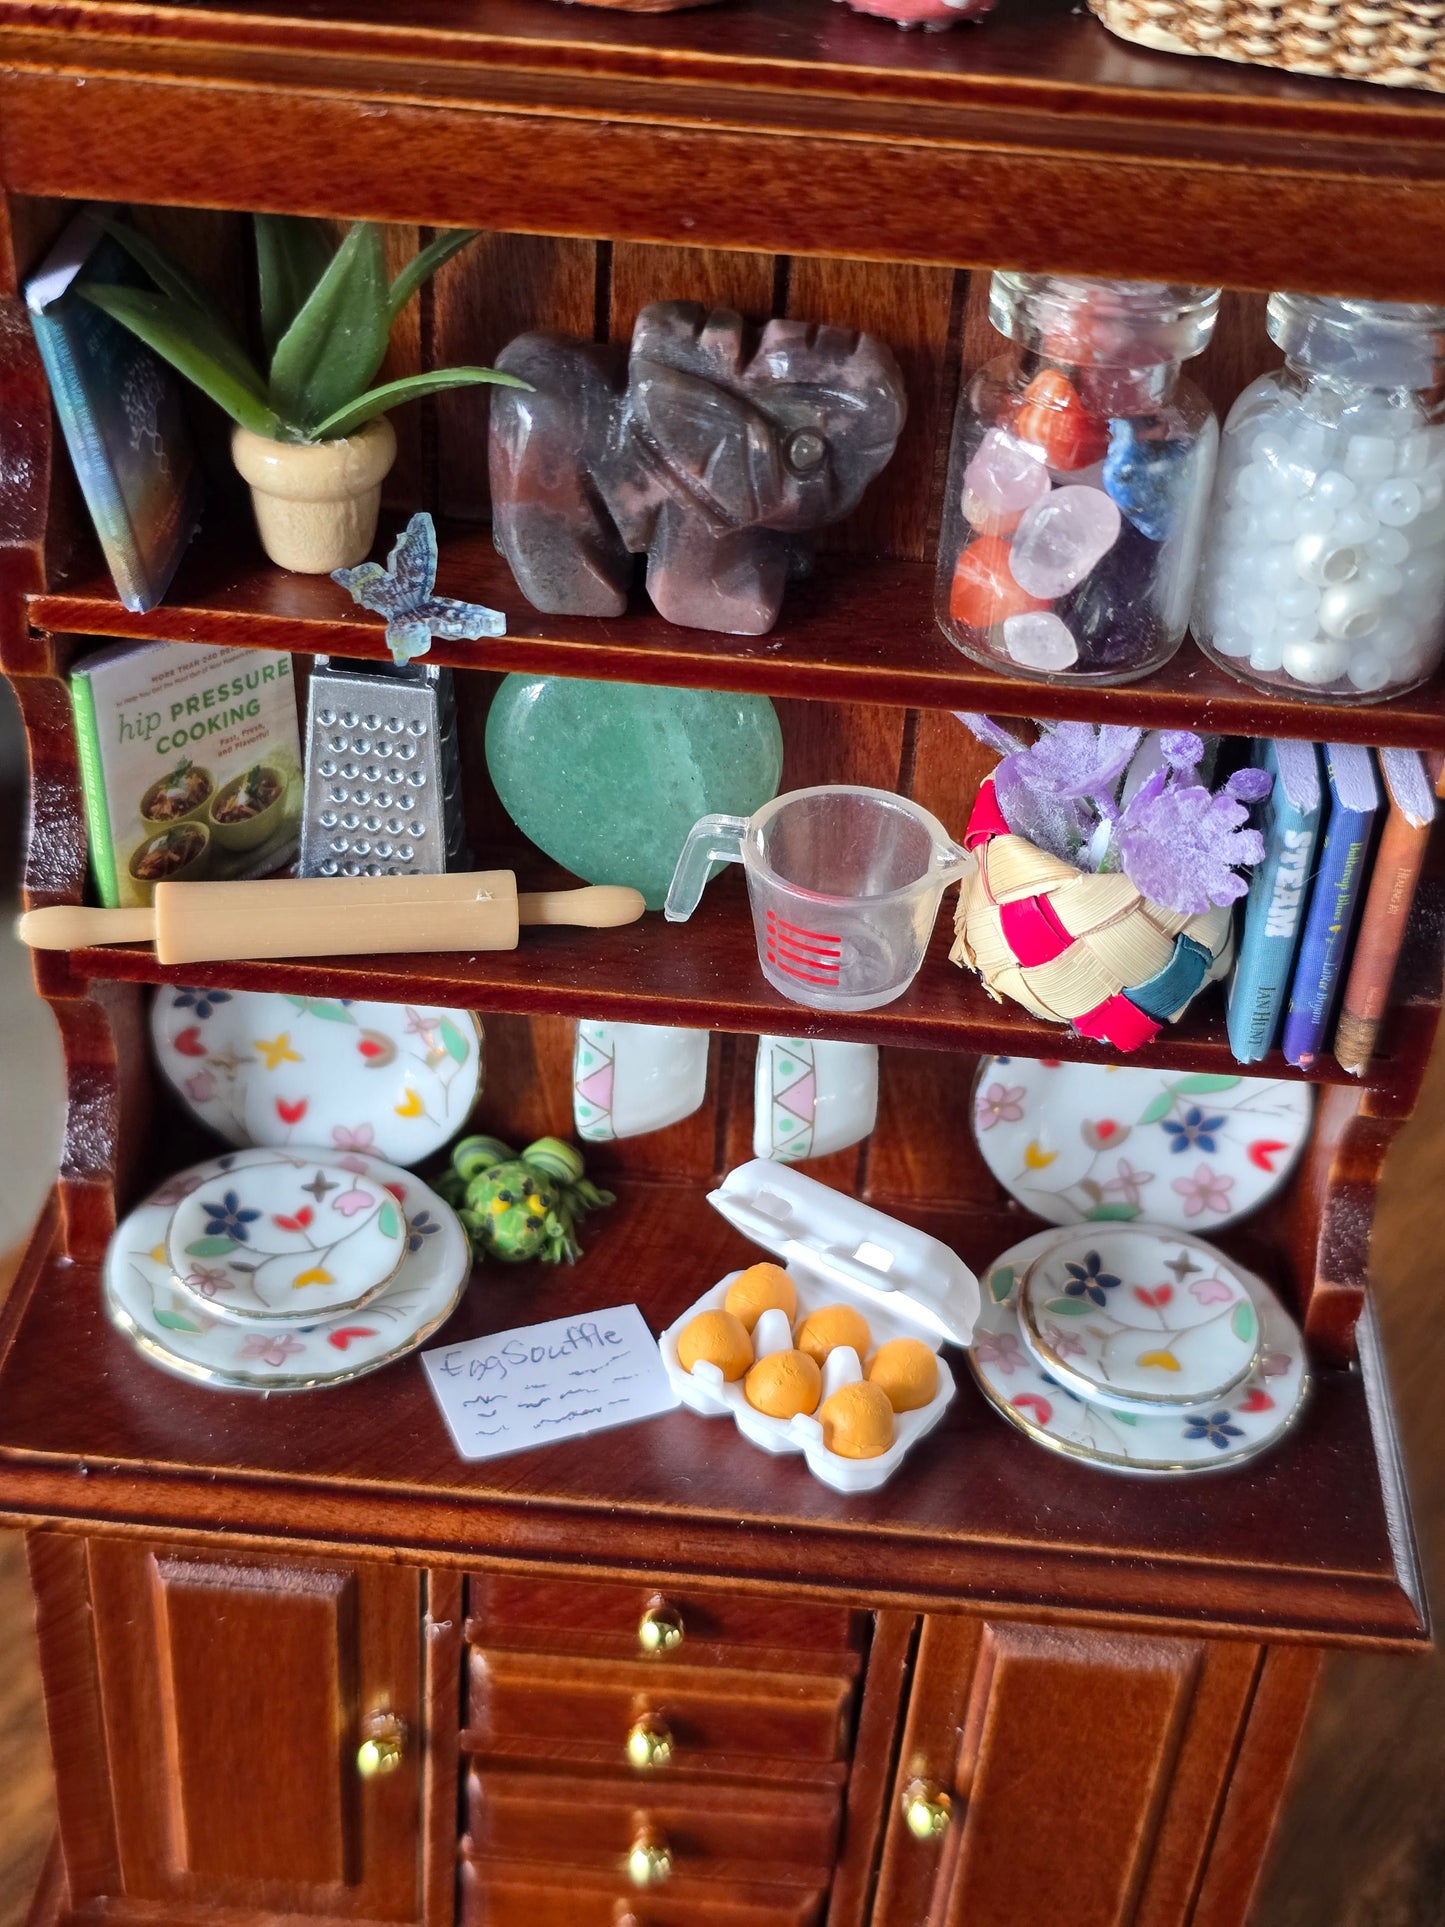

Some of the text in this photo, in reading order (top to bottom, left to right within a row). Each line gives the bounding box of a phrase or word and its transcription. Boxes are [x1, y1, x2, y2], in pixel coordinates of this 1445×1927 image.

[118, 657, 290, 745] hip PRESSURE
[156, 698, 261, 754] COOKING
[90, 799, 104, 855] COOKING
[1264, 829, 1312, 938] STEAM
